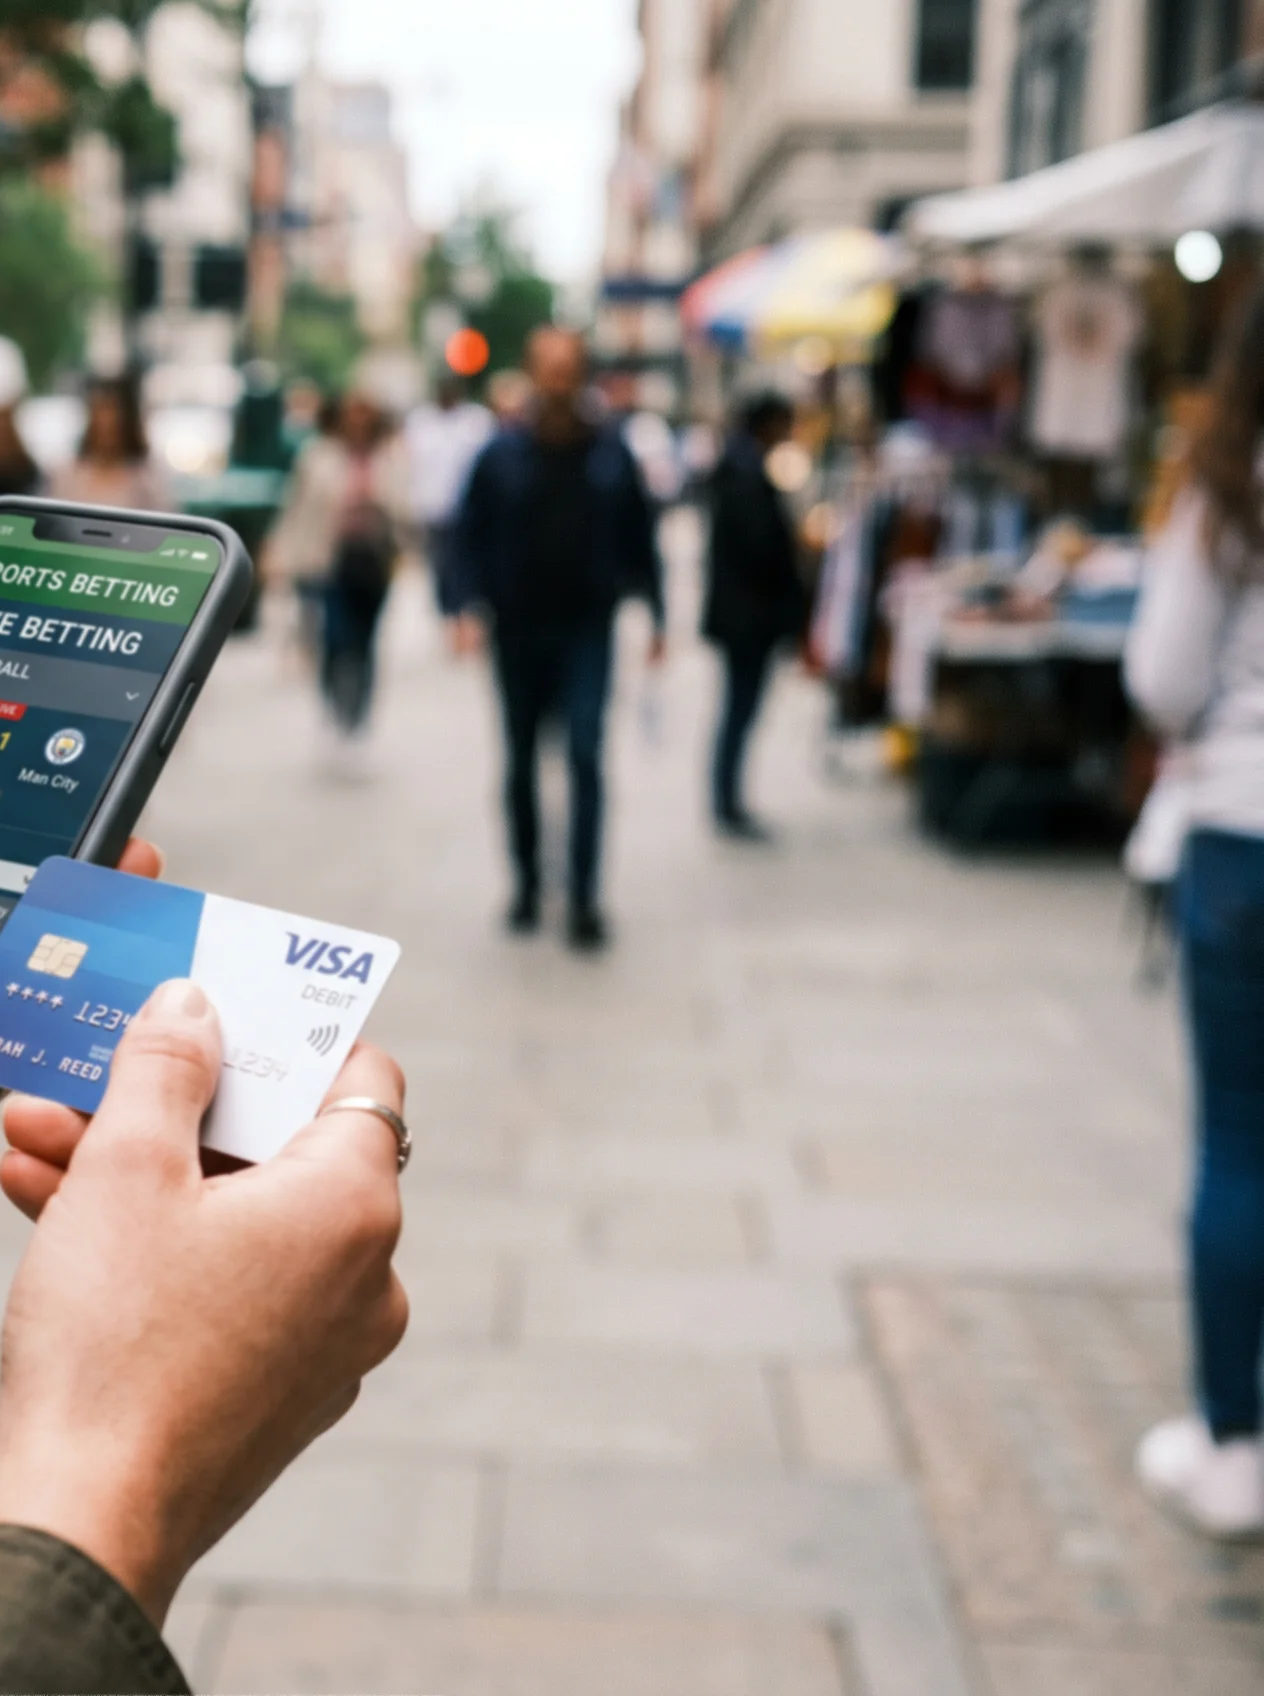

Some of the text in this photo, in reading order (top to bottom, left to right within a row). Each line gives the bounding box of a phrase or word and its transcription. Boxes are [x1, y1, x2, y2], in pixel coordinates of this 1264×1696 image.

[69, 572, 180, 607] BETTING
[19, 615, 143, 655] BETTING
[18, 768, 79, 793] Man City
[284, 931, 375, 985] VISA
[300, 983, 358, 1011] DEBIT
[31, 1049, 48, 1067] J.
[58, 1055, 103, 1081] REED
